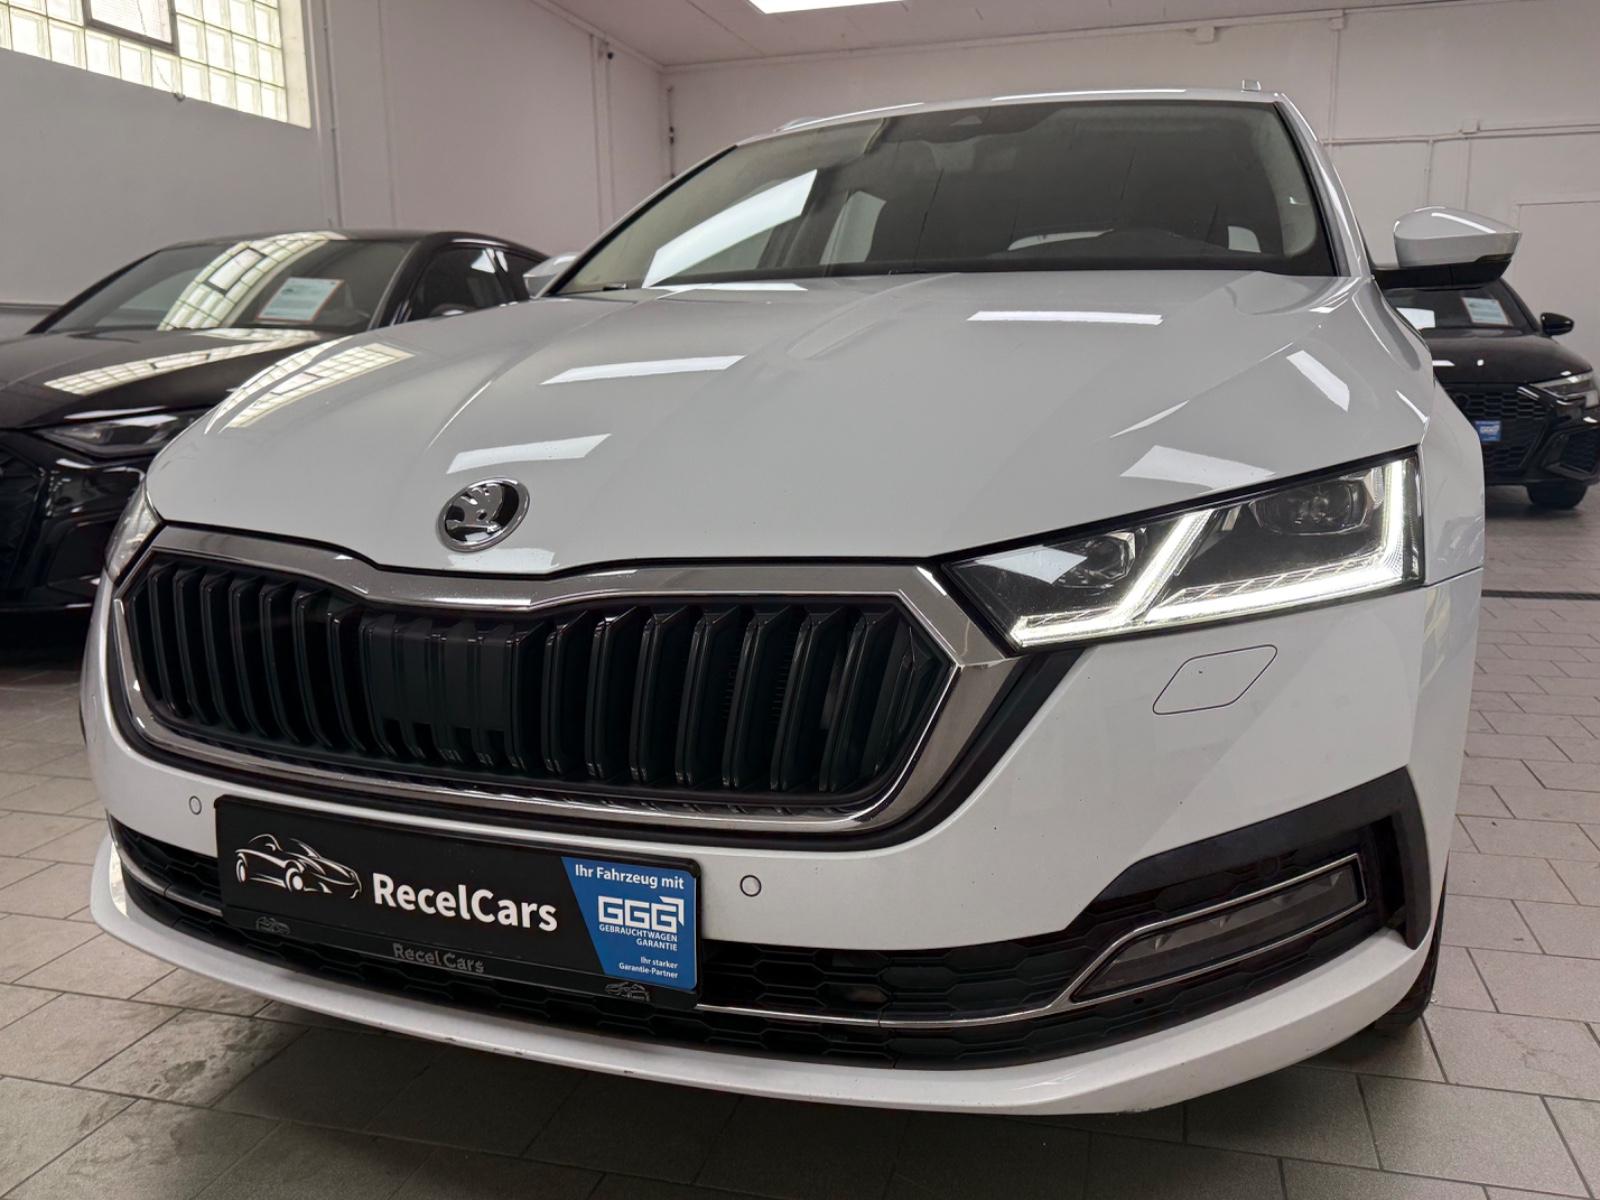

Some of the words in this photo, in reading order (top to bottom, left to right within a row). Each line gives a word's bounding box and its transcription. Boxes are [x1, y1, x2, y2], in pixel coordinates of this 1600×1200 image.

[575, 864, 594, 878] Ihr
[597, 866, 657, 889] Fahrzeug
[661, 876, 685, 889] mit
[372, 872, 558, 932] RecelCars
[597, 895, 685, 933] GGG
[599, 924, 677, 942] GEBRAUCHTWAGEN
[636, 938, 678, 952] GARANTIE
[619, 962, 678, 978] Garantie-Partner
[640, 956, 651, 965] Ihr
[652, 958, 678, 969] starker
